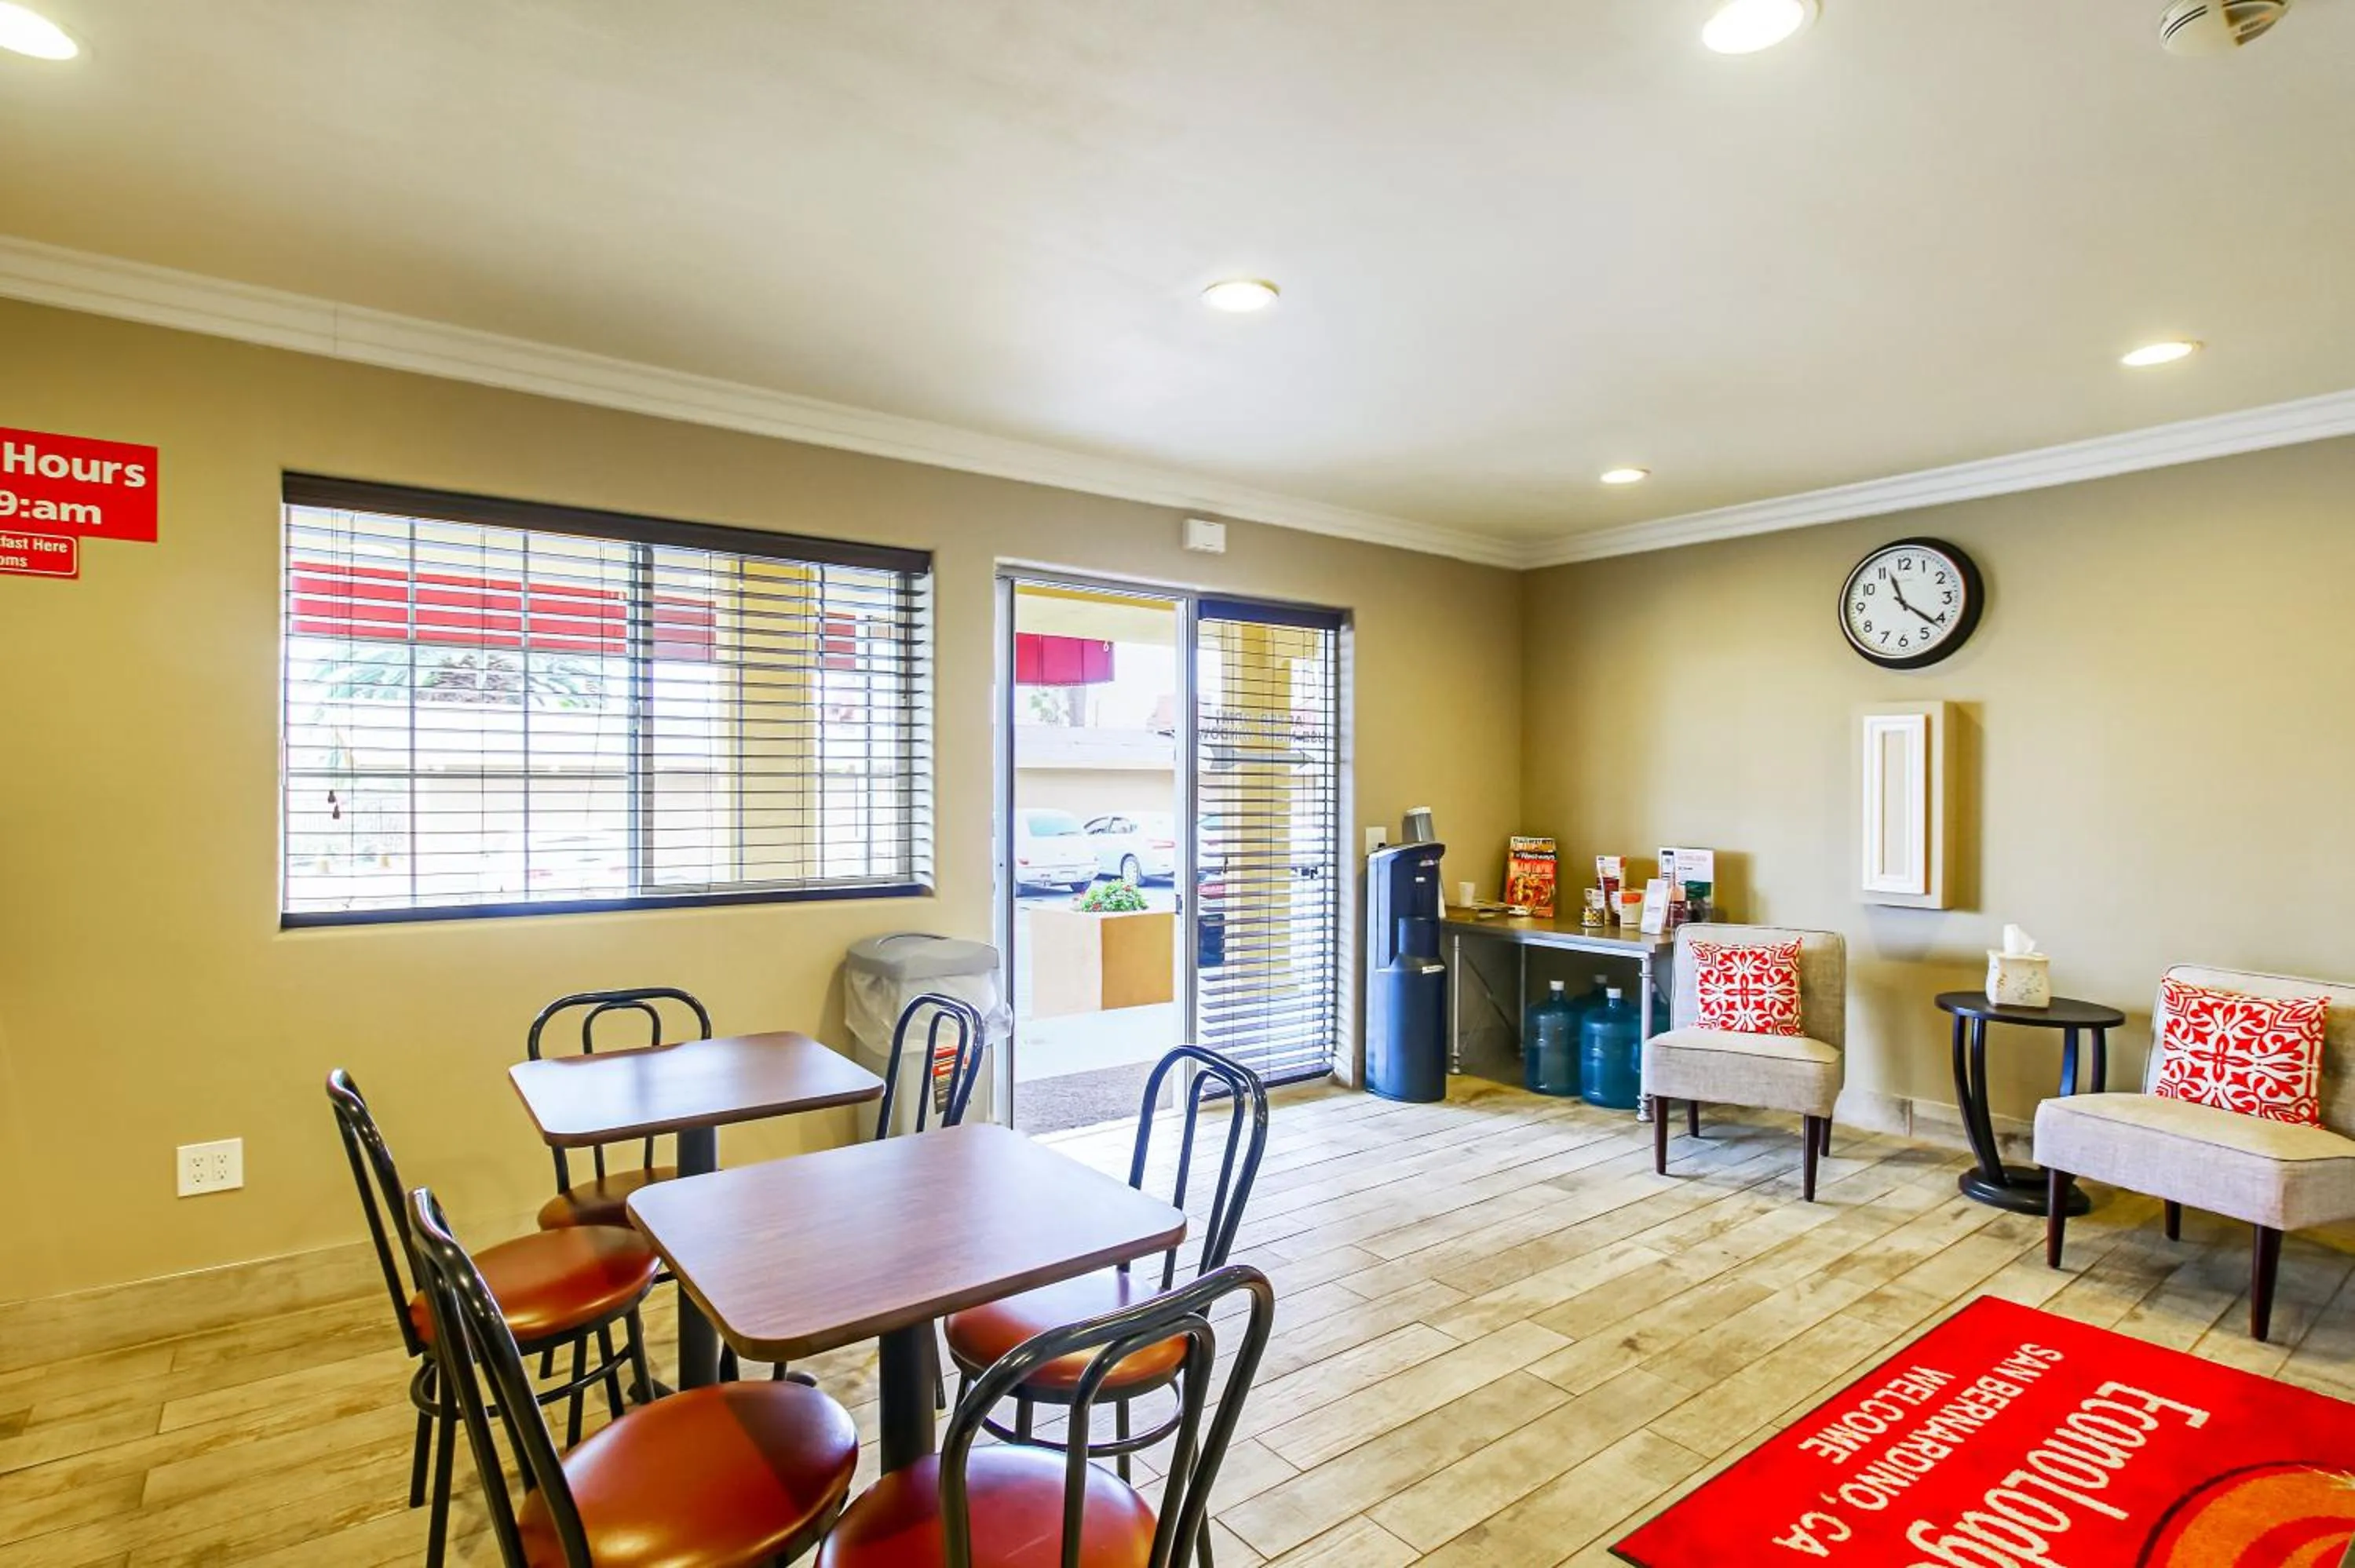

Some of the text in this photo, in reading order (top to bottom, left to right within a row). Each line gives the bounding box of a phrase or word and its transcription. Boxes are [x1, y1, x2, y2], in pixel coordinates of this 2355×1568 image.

[3, 441, 146, 487] Hours
[0, 489, 102, 525] 9:am
[0, 535, 68, 553] fast Here
[1897, 558, 1911, 571] 12
[1922, 560, 1926, 573] 1
[1879, 567, 1886, 580] 11
[1935, 571, 1946, 585] 2
[1863, 584, 1875, 596] 10
[1942, 591, 1952, 605] 3
[1856, 602, 1866, 613] 9
[1935, 612, 1946, 624] 4
[1863, 620, 1872, 633] 8
[1880, 631, 1891, 644] 7
[1920, 627, 1930, 640] 5
[1898, 634, 1908, 647] 6
[1798, 1365, 1956, 1464] WELCOME
[1772, 1343, 2065, 1557] SAN BERNARDINO, CA
